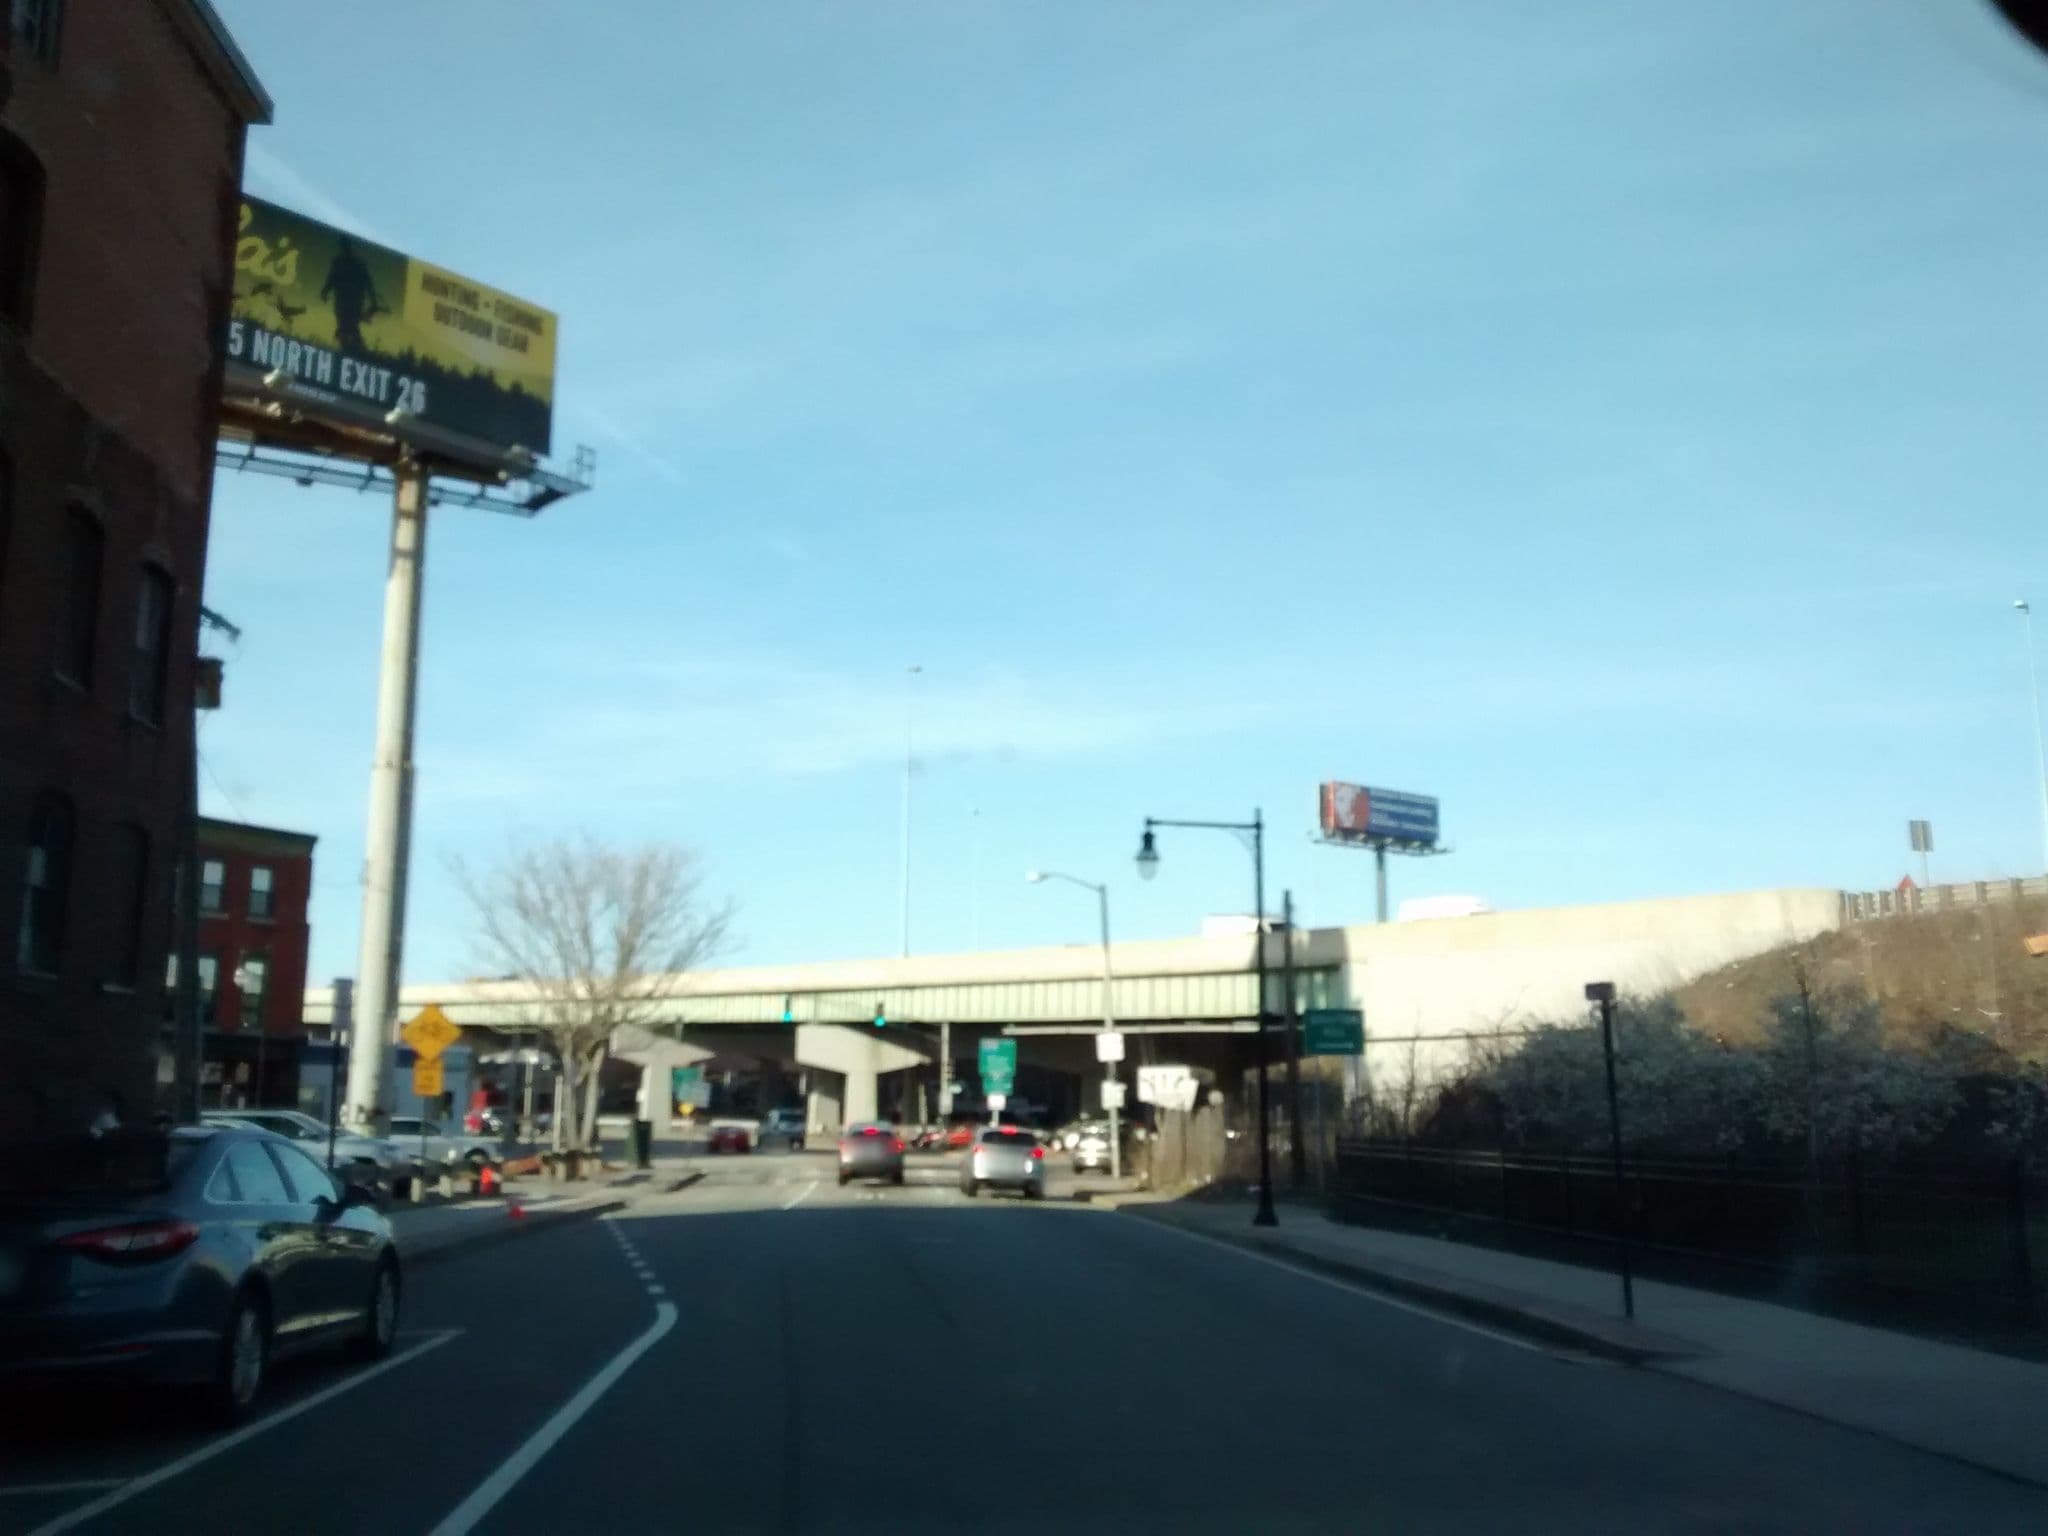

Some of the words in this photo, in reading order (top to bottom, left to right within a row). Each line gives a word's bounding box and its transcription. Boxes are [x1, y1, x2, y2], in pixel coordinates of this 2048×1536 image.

[252, 328, 333, 384] NORTH
[340, 358, 393, 402] EXIT
[396, 376, 428, 415] 26
